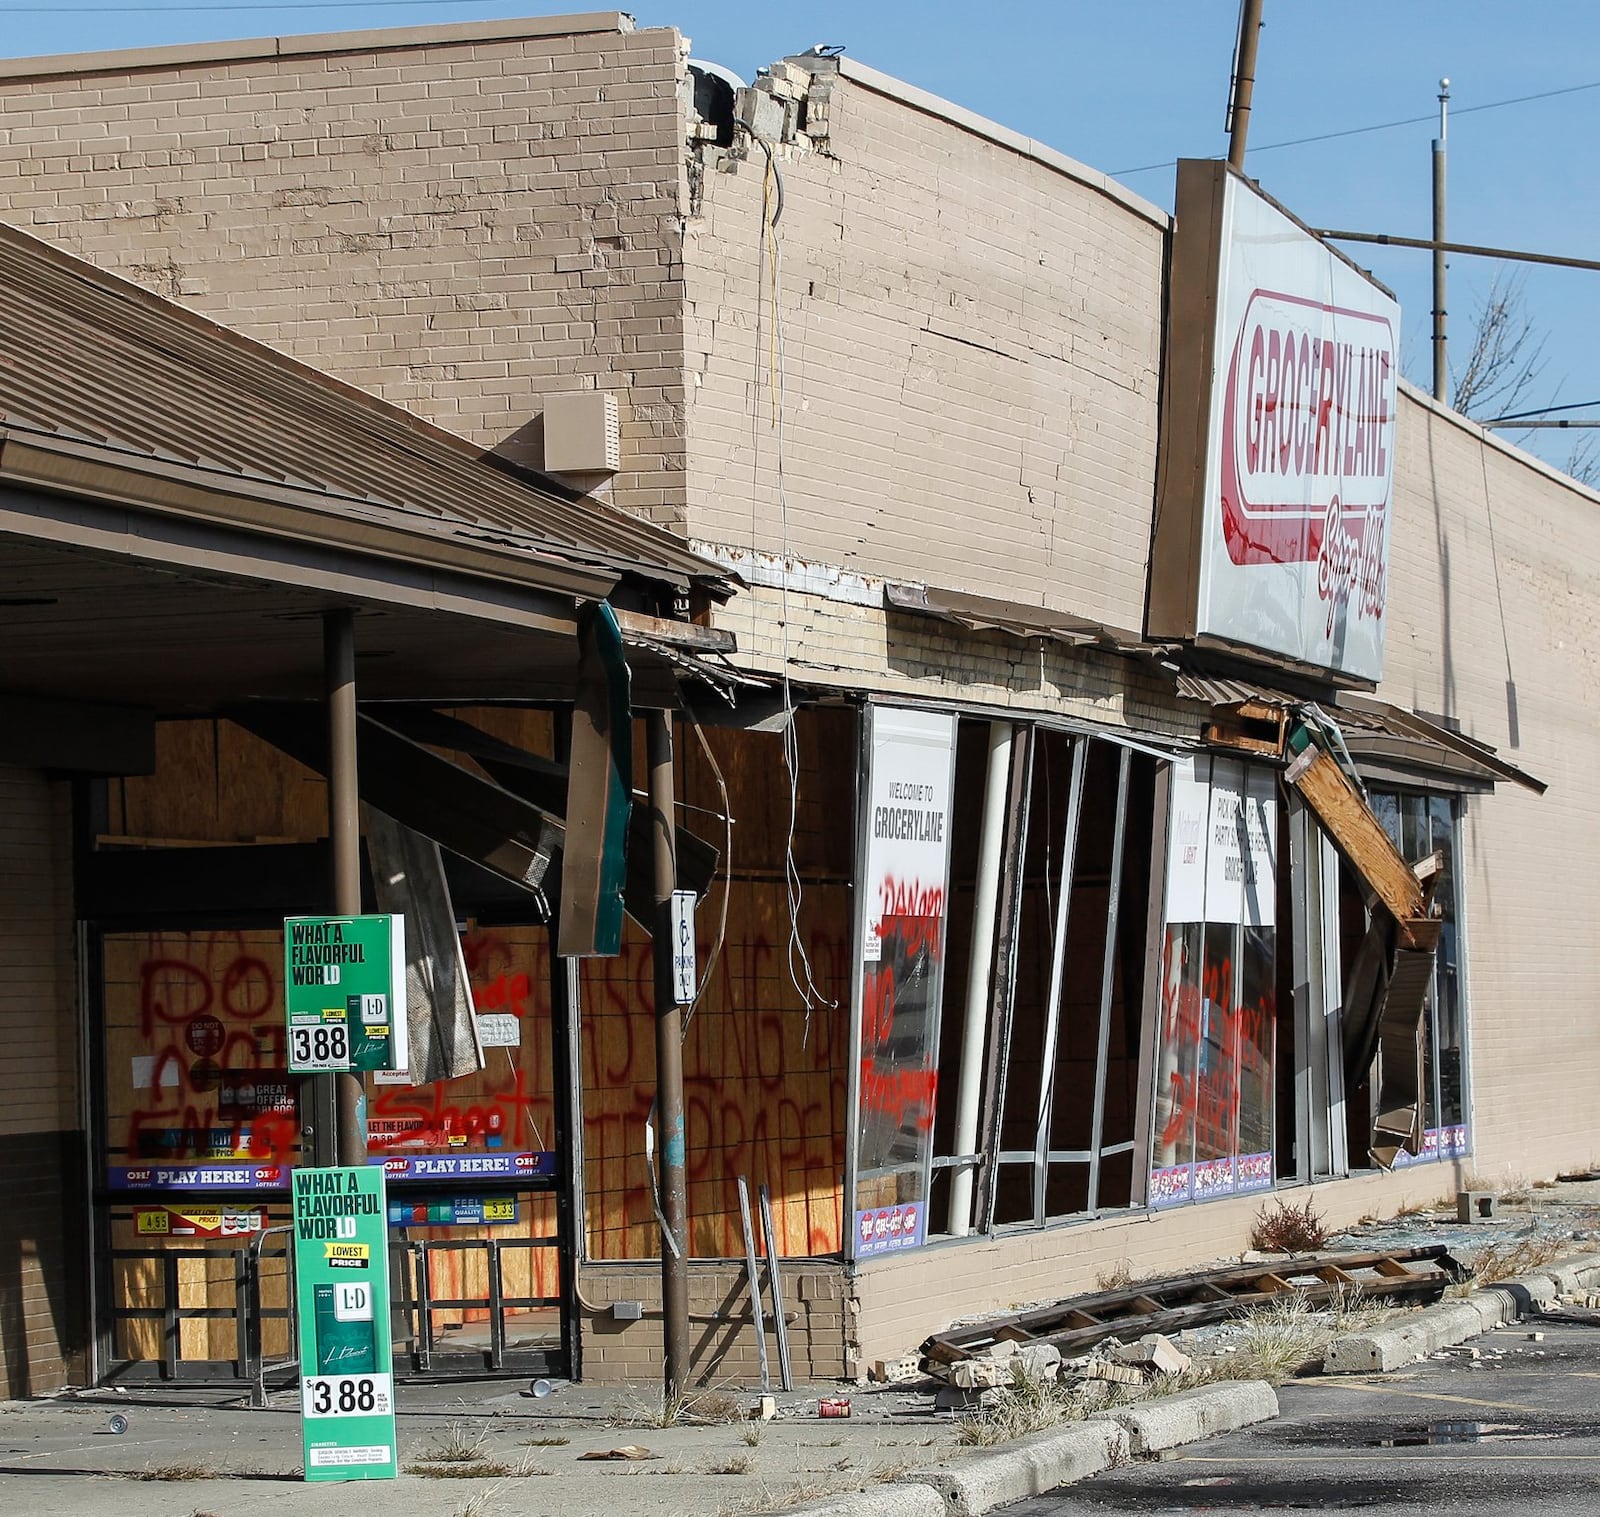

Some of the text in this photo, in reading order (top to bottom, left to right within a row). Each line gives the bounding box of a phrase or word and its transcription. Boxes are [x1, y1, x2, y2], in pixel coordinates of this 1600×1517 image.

[1247, 323, 1390, 478] GROCERYLANE
[889, 781, 934, 802] WELCOME TO
[874, 806, 944, 842] GROCERYLANE
[292, 923, 343, 945] WHAT A
[292, 944, 365, 965] FLAVORFUL
[292, 965, 340, 986] WORLD
[256, 1084, 288, 1095] GREAT
[256, 1095, 286, 1105] OFFER
[368, 1121, 380, 1132] LET
[382, 1120, 396, 1131] THE
[384, 1156, 539, 1174] OH! PLAY HERE! OH!
[127, 1170, 150, 1180] OH!
[157, 1170, 198, 1184] PLAY
[200, 1169, 250, 1183] HERE!
[296, 1172, 359, 1195] WHAT A
[297, 1193, 381, 1218] FLAVORFUL
[455, 1198, 480, 1208] FEEL
[298, 1216, 357, 1240] WORLD
[332, 1246, 363, 1257] LOWEST
[331, 1259, 362, 1267] PRICE
